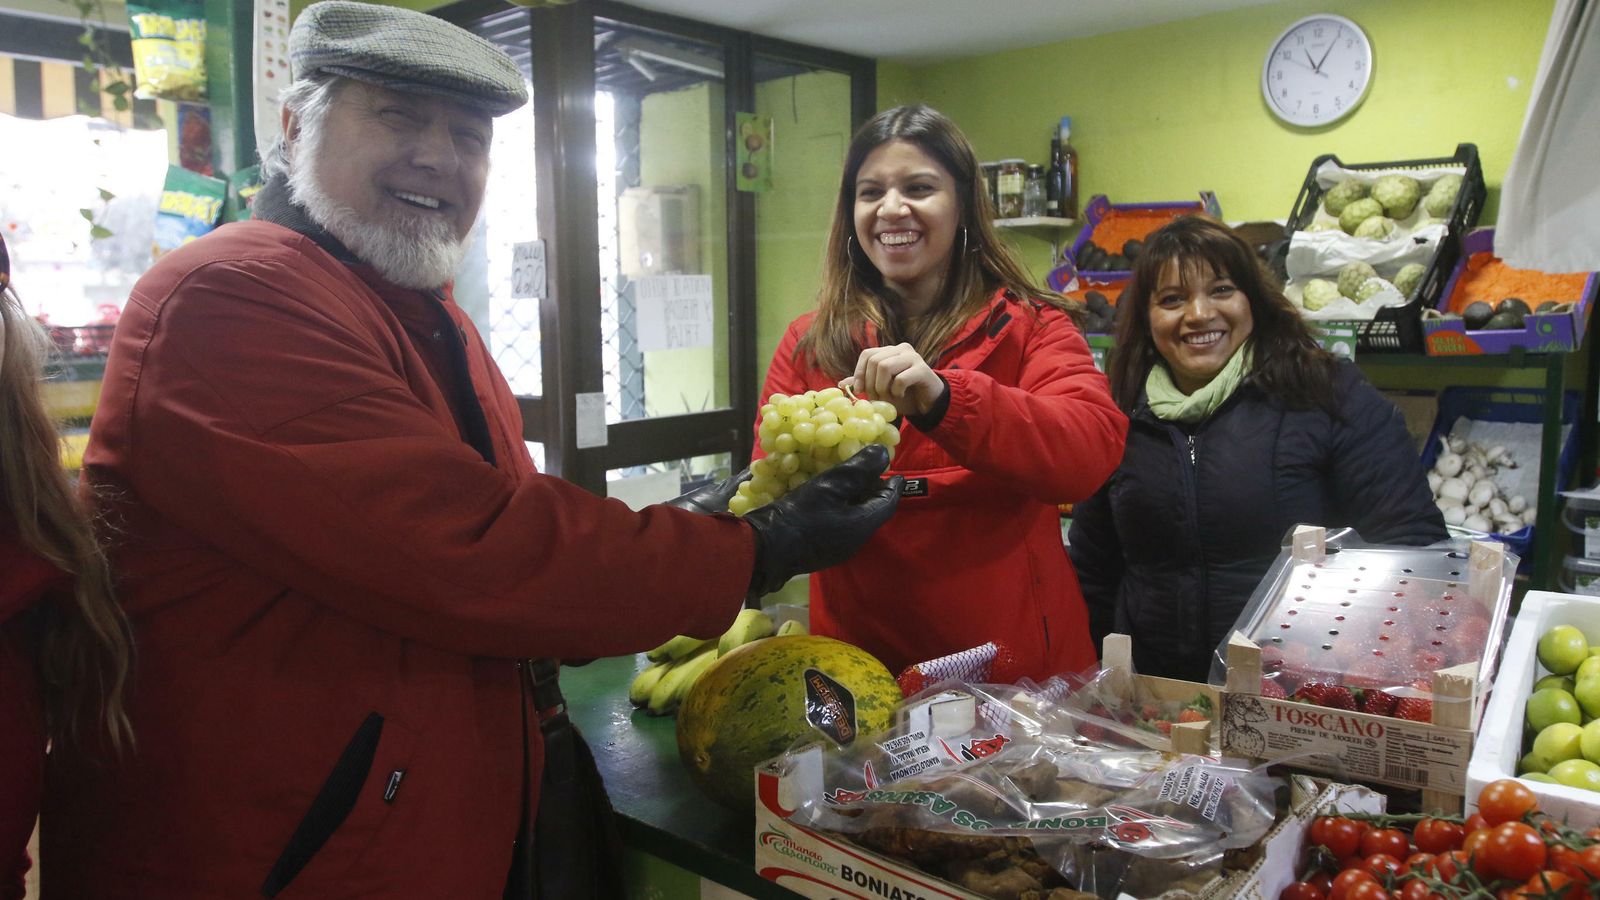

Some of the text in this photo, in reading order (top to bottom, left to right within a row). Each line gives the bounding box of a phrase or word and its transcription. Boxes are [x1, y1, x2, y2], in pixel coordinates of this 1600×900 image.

[1314, 28, 1323, 39] 12
[1347, 38, 1354, 49] 2
[1348, 80, 1354, 89] 4
[1297, 100, 1302, 110] 7
[1335, 96, 1341, 107] 5
[1313, 104, 1319, 114] 6
[1271, 703, 1384, 738] TOSCANO
[914, 745, 931, 756] NERJA
[891, 756, 941, 781] MANOLO CASANOVA
[783, 838, 823, 862] Manolo
